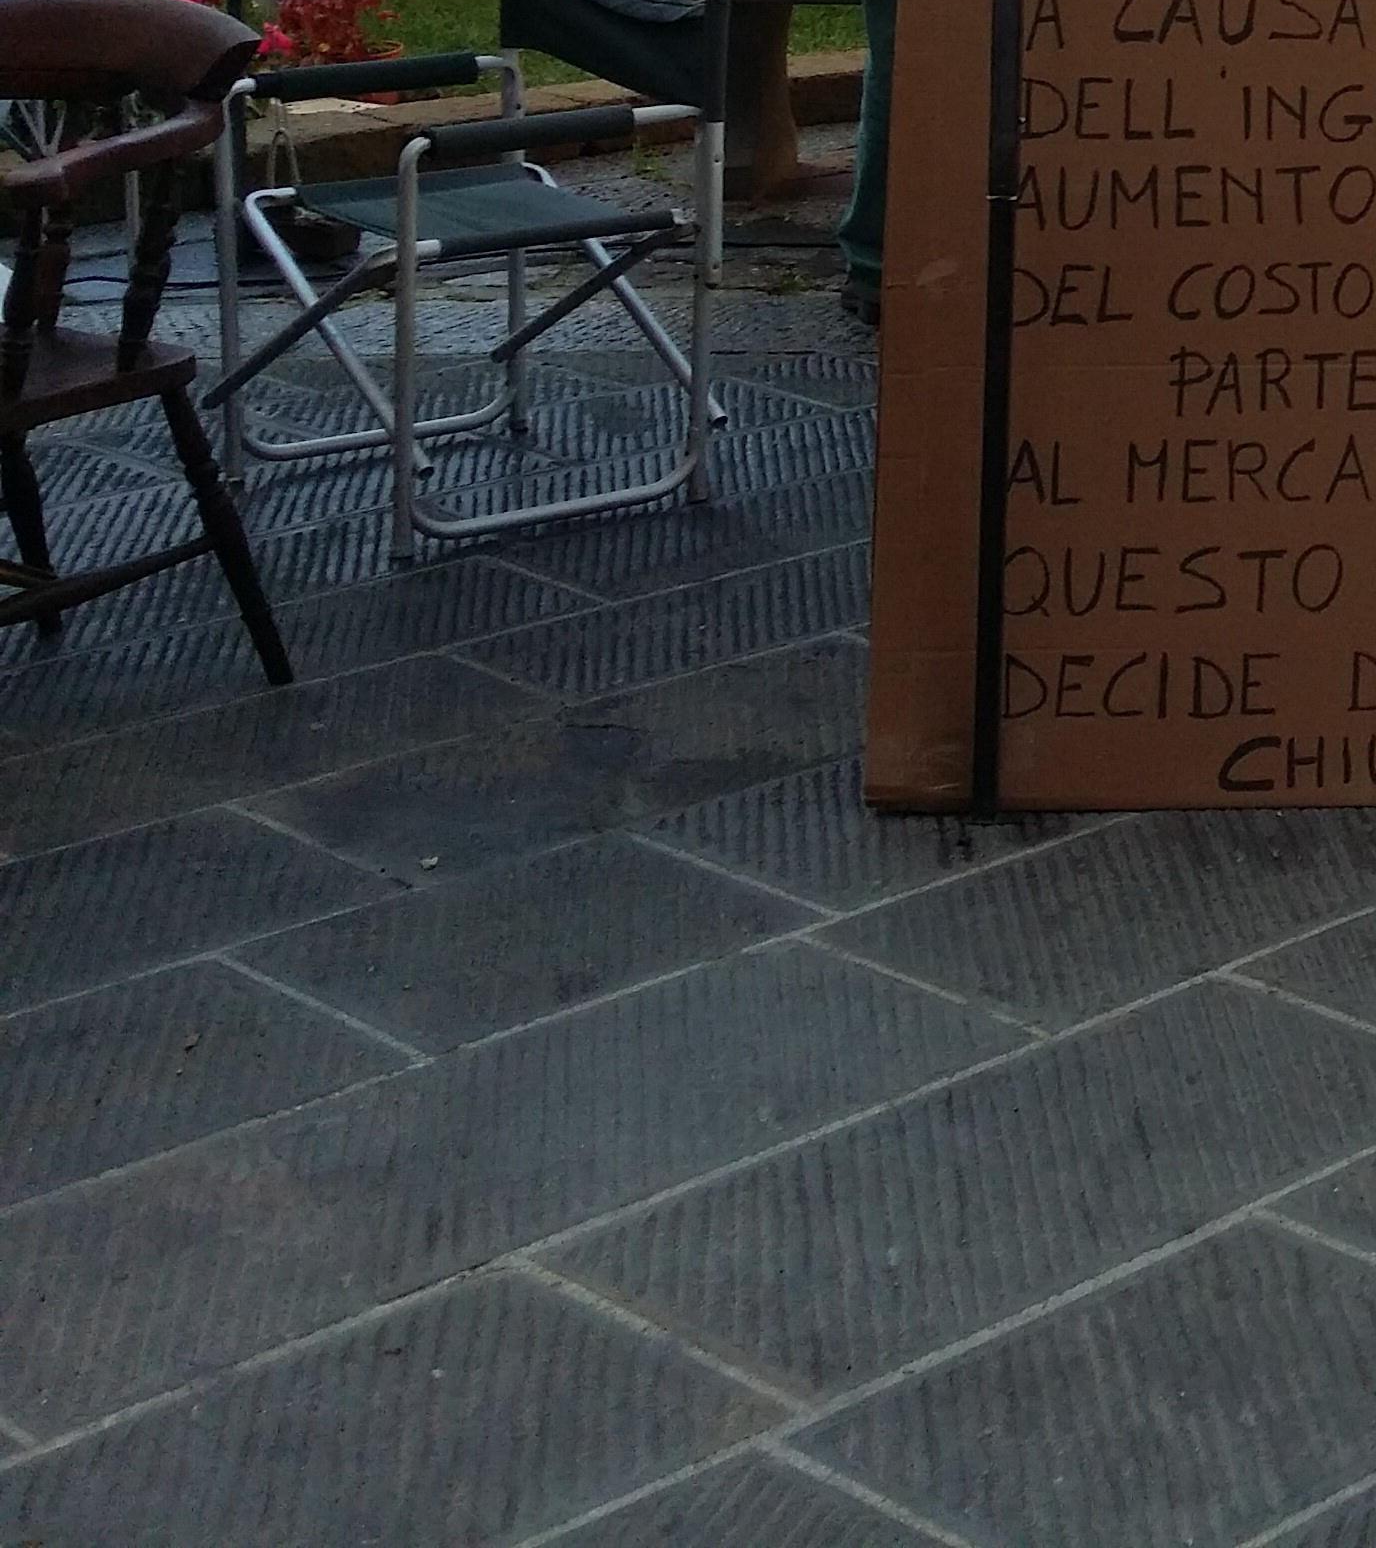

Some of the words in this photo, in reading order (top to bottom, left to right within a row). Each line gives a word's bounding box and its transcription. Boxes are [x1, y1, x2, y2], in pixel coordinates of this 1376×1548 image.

[1015, 164, 1376, 231] AUMENTO
[1011, 264, 1133, 328] DEL
[1167, 261, 1374, 320] COSTO
[1007, 439, 1082, 506] AL
[1003, 543, 1343, 617] QUESTO
[1002, 651, 1281, 719] DECIDE
